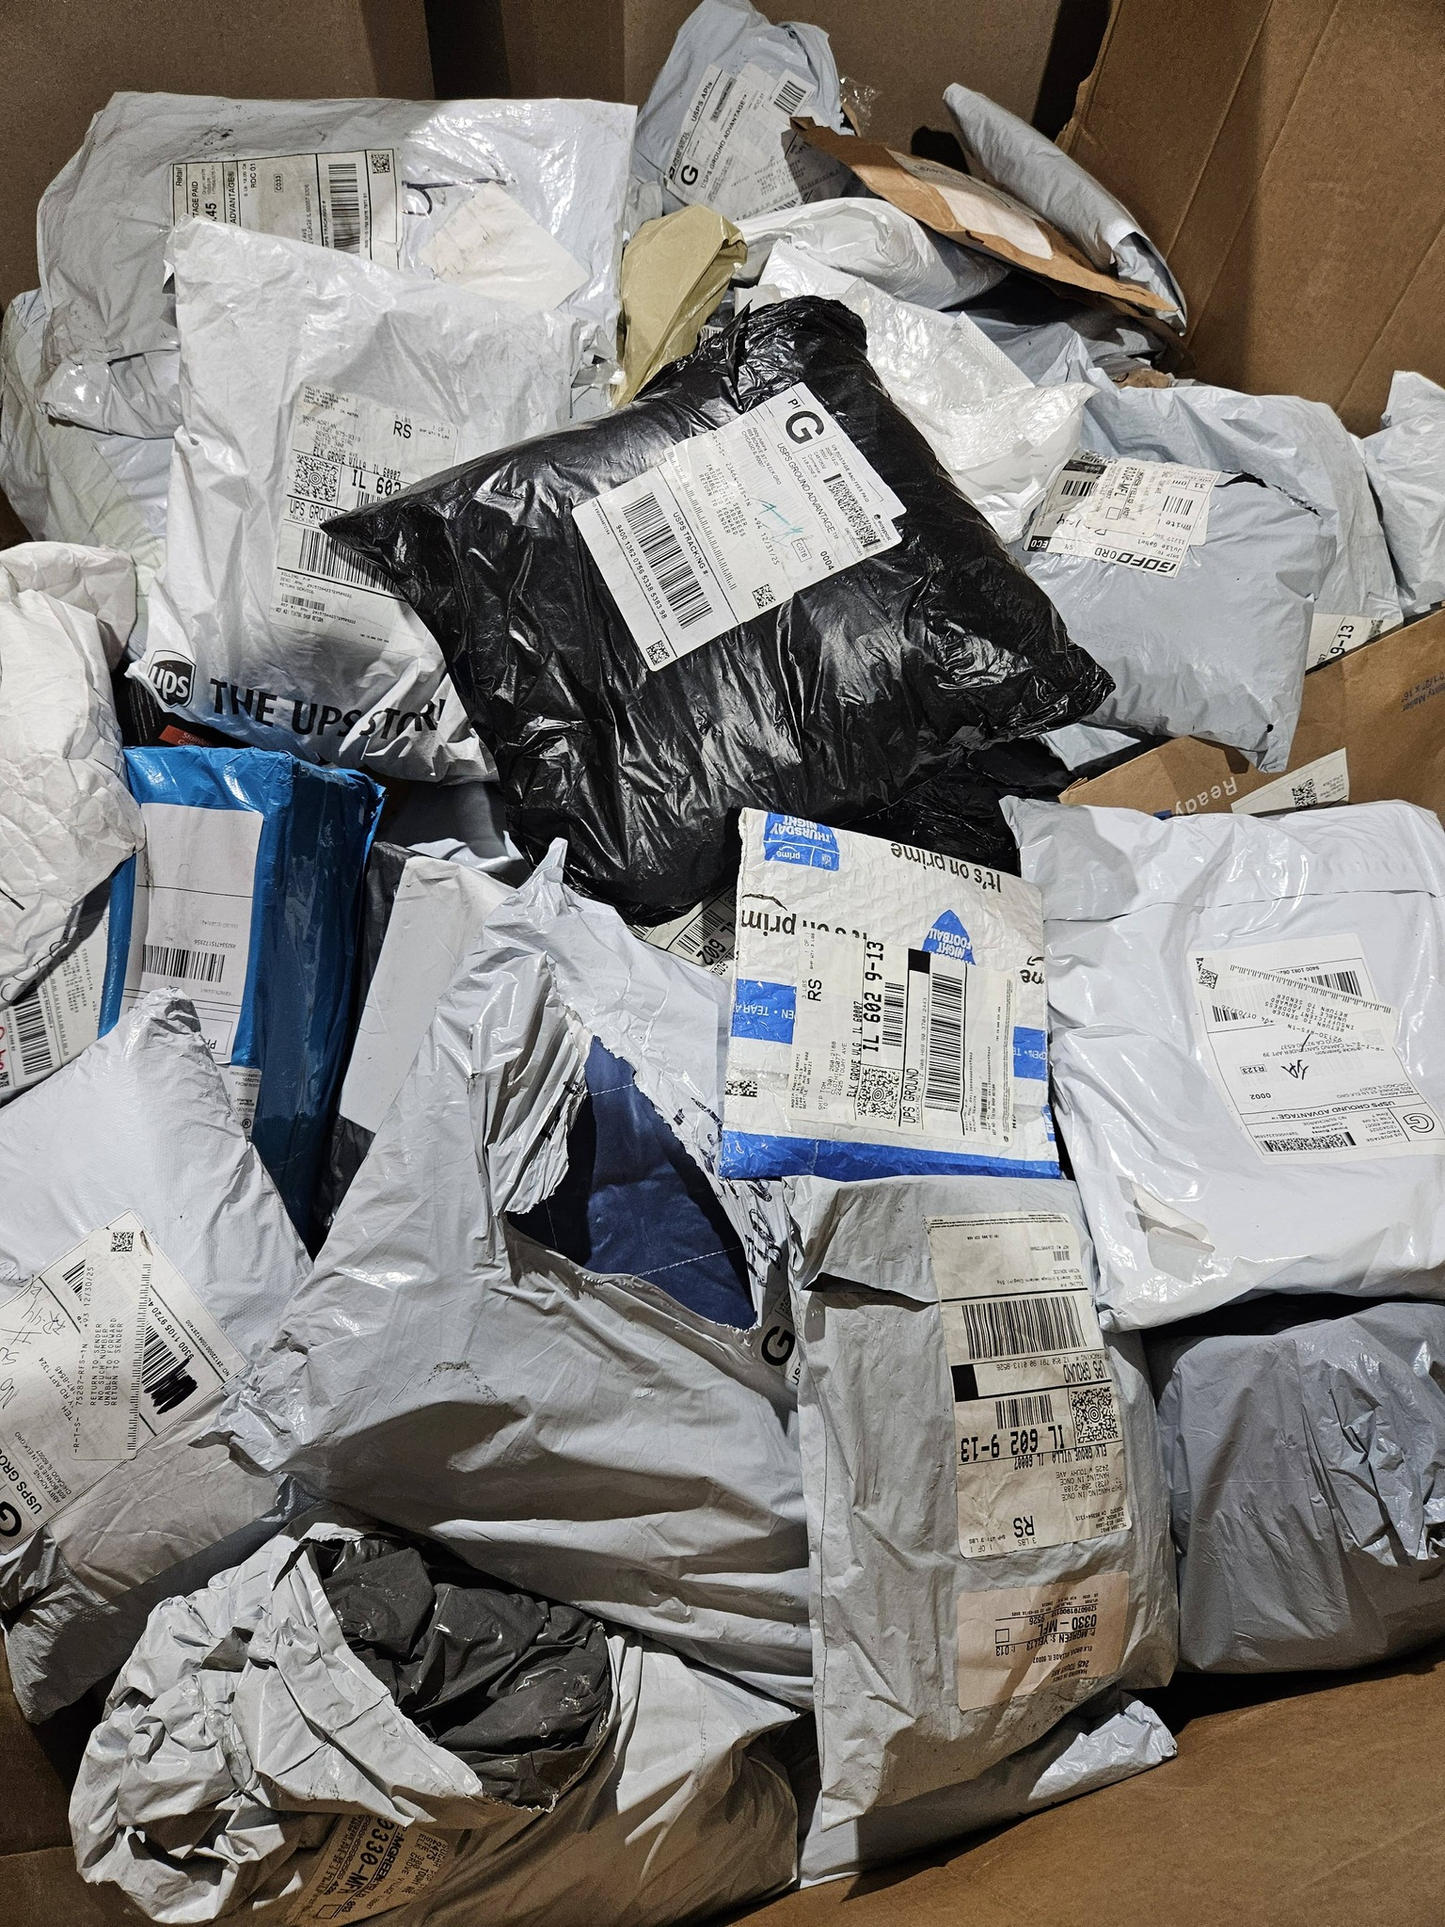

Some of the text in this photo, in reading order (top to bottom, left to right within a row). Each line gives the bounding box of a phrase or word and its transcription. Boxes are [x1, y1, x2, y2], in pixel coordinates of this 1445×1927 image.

[690, 100, 704, 122] USPS
[249, 163, 256, 171] 01
[676, 162, 701, 188] G
[699, 168, 713, 189] USPS
[708, 139, 726, 169] GROUND
[191, 197, 199, 218] TAGE
[392, 420, 413, 439] RS
[786, 410, 825, 444] G
[312, 448, 324, 458] ELK
[326, 450, 346, 465] GROVE
[775, 441, 811, 493] USPS GROUND
[351, 469, 401, 497] IL 602
[288, 499, 306, 516] UPS
[697, 472, 732, 535] RETURN TO SENDER
[702, 470, 739, 536] UNABLE FORWARD
[705, 462, 747, 538] INSUFFICIENT ADDRESS
[714, 466, 749, 527] RETURN SENDER
[671, 510, 706, 569] USPS TRACKING
[758, 531, 780, 566] 12/31/25
[1136, 538, 1182, 553] Julie Gabel
[818, 549, 835, 571] 0004
[1029, 536, 1177, 574] GOFO ORD ECO
[614, 523, 669, 620] 9400 1362 0756 5338 5383 98
[1329, 622, 1354, 656] 9-13
[146, 664, 193, 703] ups
[203, 677, 363, 743] THE UPS
[1173, 775, 1237, 816] Ready
[767, 820, 834, 842] THURSDAY
[888, 841, 1003, 893] It's on prime
[926, 928, 972, 949] FOOTBALL
[933, 939, 965, 958] NIGHT
[695, 935, 727, 968] 602
[806, 977, 822, 1001] RS
[862, 941, 884, 1051] IL 602 9-13
[742, 1003, 770, 1015] TEAR
[852, 1000, 863, 1022] 60007
[1263, 1001, 1354, 1030] INSUFFICIENT ADDRESS
[1269, 997, 1347, 1022] UNABLE FORWARD
[1275, 993, 1348, 1017] RETURN SENDER
[1271, 1008, 1345, 1032] RETURN SENDER
[851, 1041, 861, 1056] VLG
[850, 1059, 860, 1080] GROVE
[1241, 1065, 1264, 1074] R123
[846, 1083, 857, 1097] ELK
[900, 1067, 919, 1124] UPS GROUND
[1330, 1099, 1395, 1113] USPS GROUND
[1401, 1109, 1435, 1136] G
[75, 1265, 94, 1406] 75287-RFS-1N 12/30/25
[150, 1305, 196, 1361] 9300 1105 9720
[756, 1321, 799, 1369] G
[36, 1356, 52, 1374] 1324
[89, 1322, 102, 1406] RETURN TO SENDER
[96, 1327, 108, 1401] NO SUCH NUMBER
[103, 1316, 117, 1406] UNABLE TO FORWARD
[110, 1321, 123, 1406] RETURN TO SENDER
[1061, 1359, 1107, 1383] UPS GROUND
[47, 1372, 62, 1389] APT
[58, 1386, 70, 1400] RD
[13, 1430, 35, 1456] ELK GRO
[958, 1423, 1064, 1462] IL 602 9-13
[1036, 1443, 1107, 1466] ELK GROVE VILLA IL
[1054, 1466, 1087, 1478] TOUHY AVE
[1059, 1471, 1110, 1485] HANGING ONCE
[13, 1479, 45, 1515] USPS
[46, 1487, 61, 1504] ABBY
[1060, 1487, 1111, 1501] HANGING ONCE
[0, 1499, 23, 1538] G
[1011, 1514, 1035, 1538] RS
[975, 1544, 985, 1552] OF
[1016, 1537, 1029, 1546] LBS
[1028, 1614, 1045, 1625] 9526
[1036, 1613, 1098, 1636] 0330 MFL
[994, 1628, 1088, 1657] MGREEN YELL13 013
[1076, 1658, 1090, 1668] 2425
[400, 1832, 426, 1876] ELK GROVE
[411, 1835, 433, 1870] STE 300
[411, 1838, 442, 1888] 2475 TOUHY
[432, 1843, 449, 1868] SUGAR
